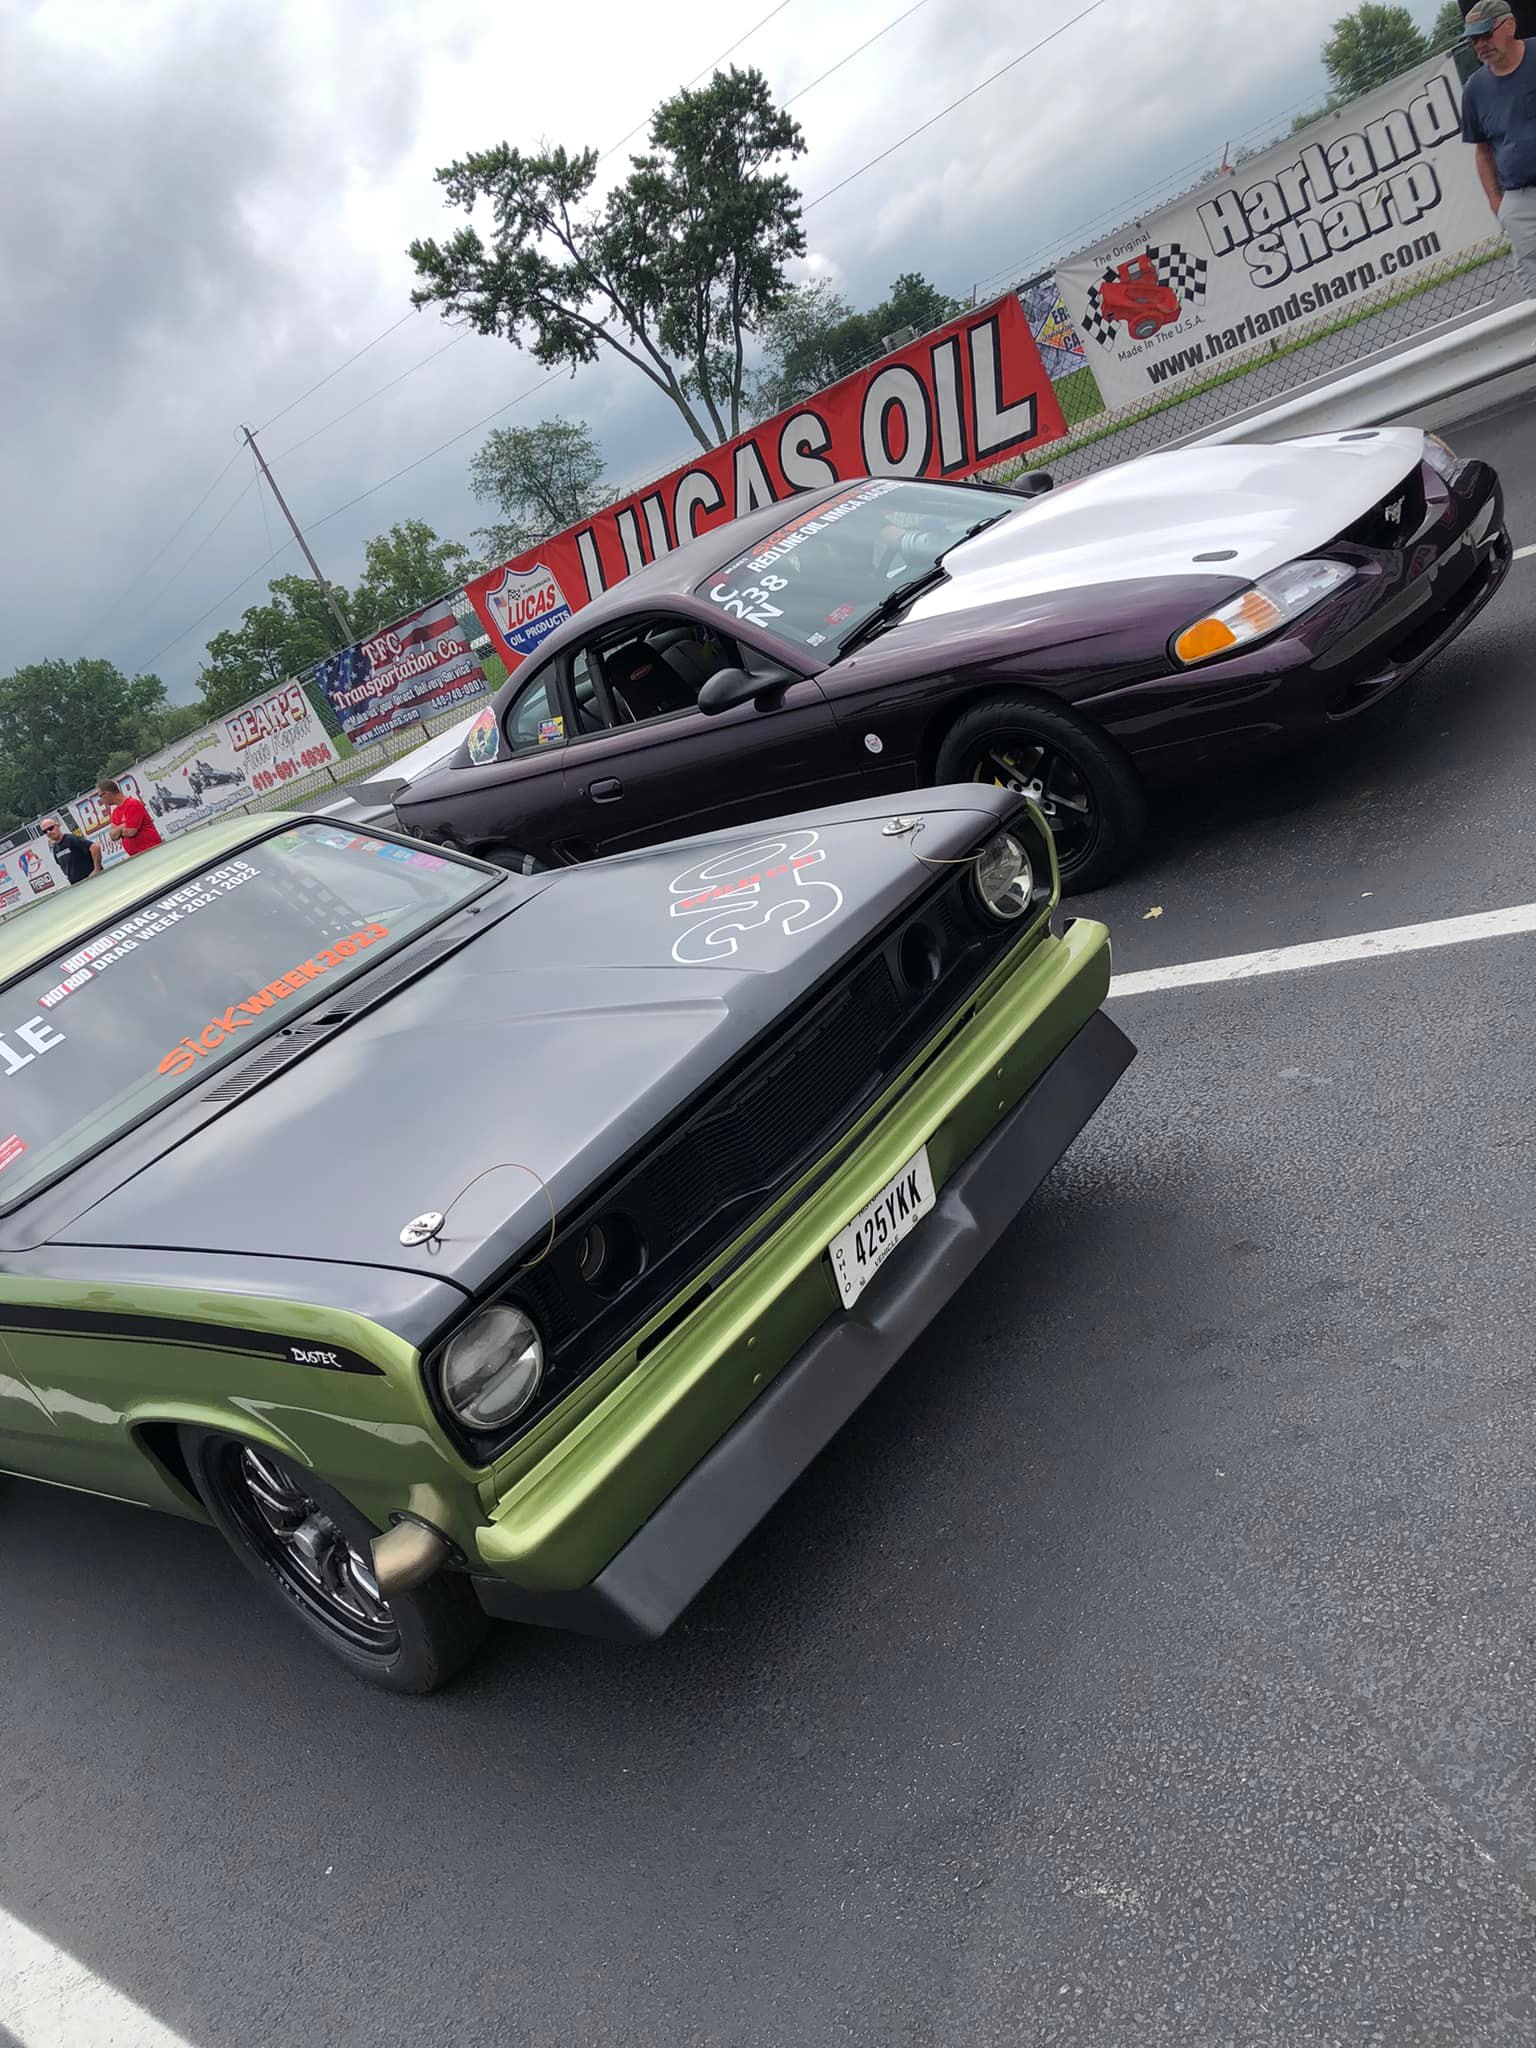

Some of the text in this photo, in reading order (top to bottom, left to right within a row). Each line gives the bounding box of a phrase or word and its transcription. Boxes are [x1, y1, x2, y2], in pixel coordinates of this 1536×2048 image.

[1196, 75, 1462, 257] Harland
[1093, 232, 1152, 267] The Original
[1243, 161, 1442, 288] Sharp
[1118, 315, 1205, 361] Made In The U.S.A.
[1146, 231, 1441, 385] www.harlandsharp.com
[574, 314, 1039, 600] LUCAS OIL
[747, 548, 781, 573] RED
[772, 532, 809, 554] LINE
[800, 521, 829, 535] OIL
[823, 500, 866, 524] NMCA
[508, 584, 555, 630] LUCAS
[510, 635, 526, 647] OIL
[525, 610, 570, 639] PRODUCTS
[723, 575, 788, 619] 238
[333, 640, 463, 709] Transportation Co.
[361, 633, 402, 666] TFC
[225, 684, 307, 752] BEAR'S
[76, 772, 144, 836] BER
[111, 910, 160, 941] DRAG
[158, 883, 204, 911] WEEK
[205, 860, 249, 885] 2016
[40, 867, 261, 1008] HOT ROD DRAG WEEK 2021 2022
[855, 1169, 921, 1266] 425YKK
[836, 1249, 851, 1293] OHIO
[874, 1235, 900, 1267] VEHICLE
[290, 1347, 342, 1368] DUSTER
